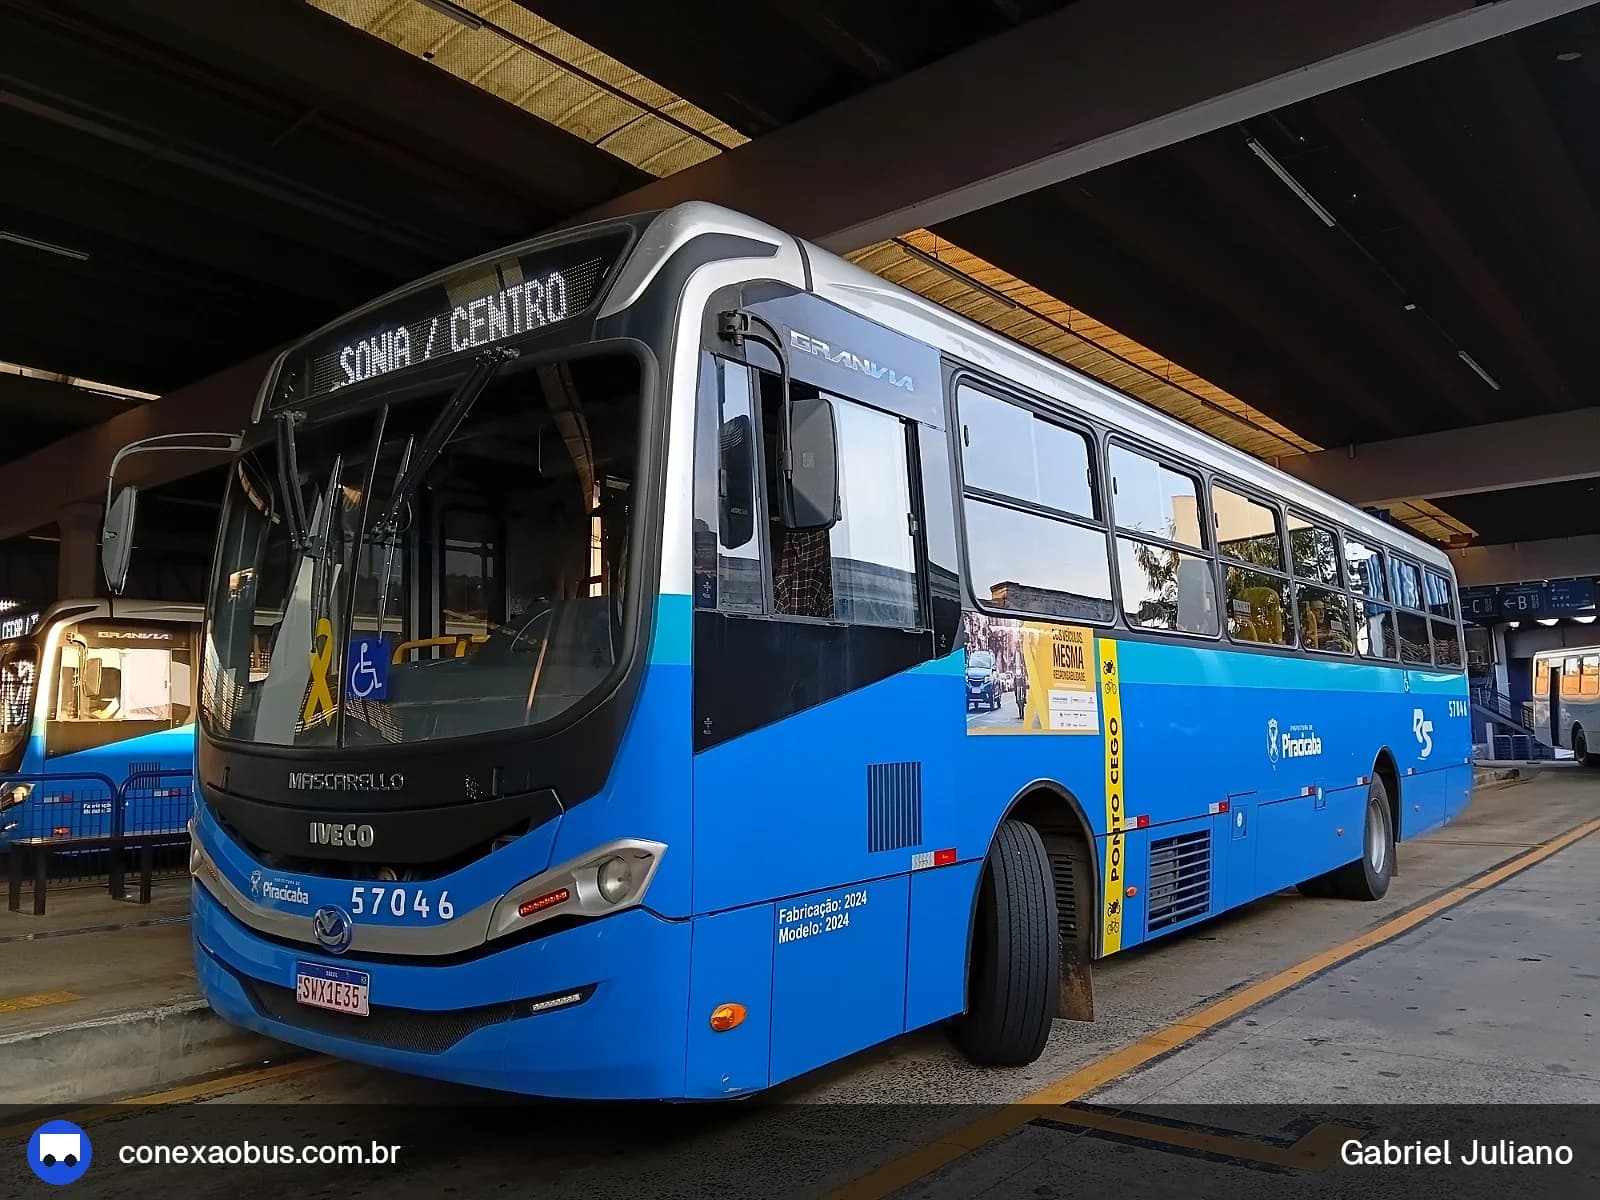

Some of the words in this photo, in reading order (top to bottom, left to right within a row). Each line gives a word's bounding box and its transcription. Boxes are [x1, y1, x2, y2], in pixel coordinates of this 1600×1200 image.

[451, 271, 567, 352] CENTRO
[790, 330, 914, 392] GRANVIA
[1472, 600, 1480, 613] C
[1518, 596, 1527, 610] B
[97, 631, 169, 640] GRANVIA
[1053, 643, 1084, 669] MESMA
[1110, 718, 1119, 784] CEGO
[1282, 732, 1321, 758] Piracicaba
[289, 773, 404, 791] MASCARELLO
[309, 822, 375, 848] IVECO
[1111, 794, 1120, 881] PONTO
[262, 881, 309, 905] Piracicaba
[351, 887, 454, 920] 57046
[779, 899, 841, 924] Fabricação:
[844, 890, 867, 909] 2024
[779, 922, 822, 944] Modelo:
[825, 912, 849, 931] 2024
[302, 977, 360, 1009] SWX1E35
